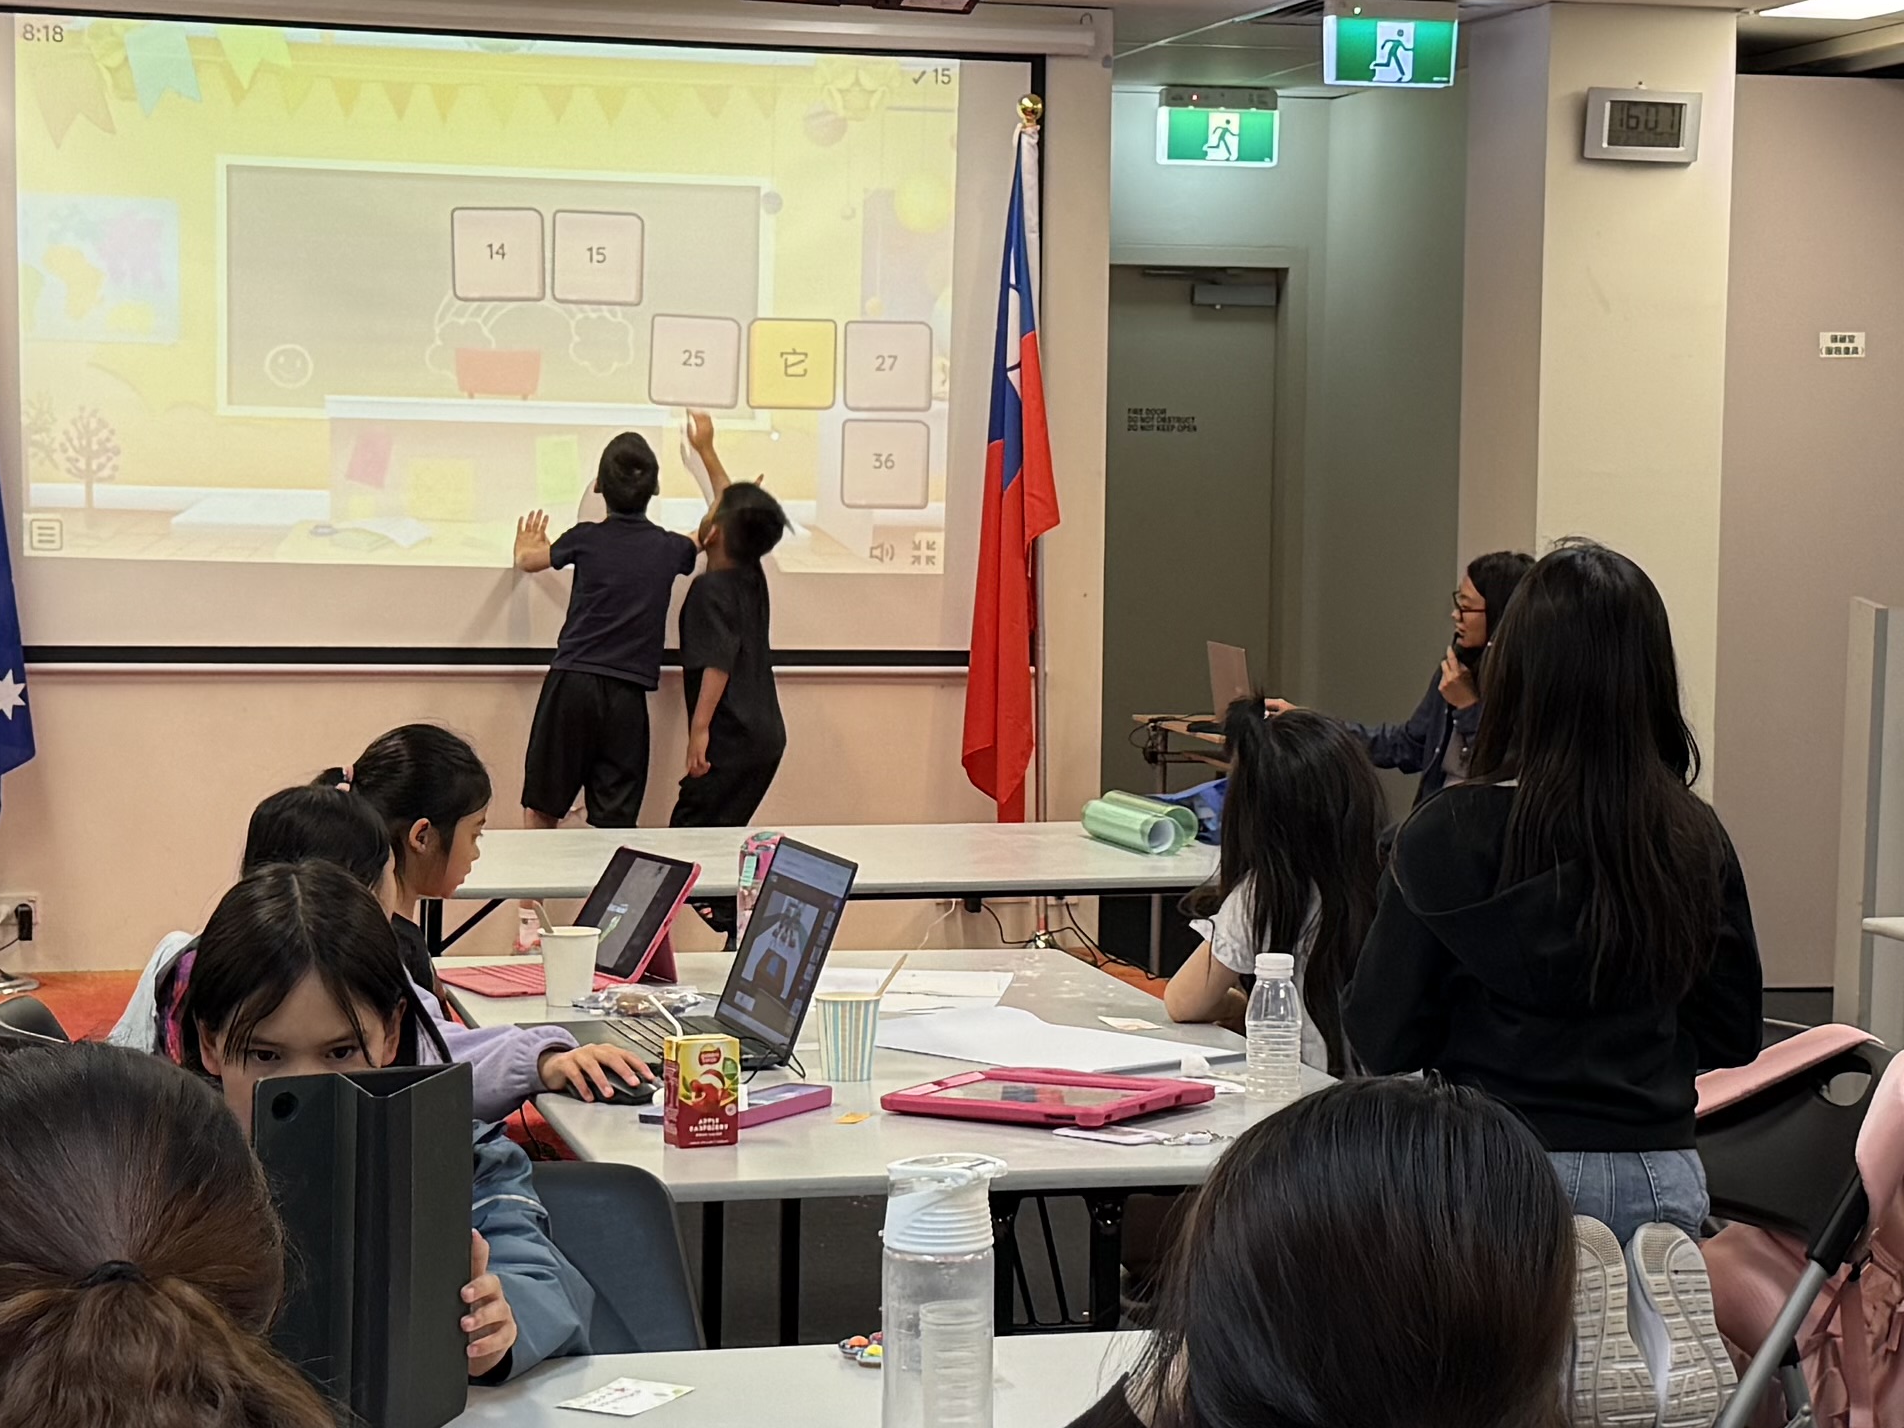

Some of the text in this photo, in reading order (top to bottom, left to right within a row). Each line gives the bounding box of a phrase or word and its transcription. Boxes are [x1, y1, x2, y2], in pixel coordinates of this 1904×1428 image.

[22, 23, 64, 43] 8:18
[932, 67, 952, 85] 15
[486, 243, 507, 260] 14
[586, 246, 607, 264] 15
[680, 349, 706, 368] 25
[779, 348, 809, 378] 它
[874, 354, 898, 372] 27
[872, 452, 896, 470] 36
